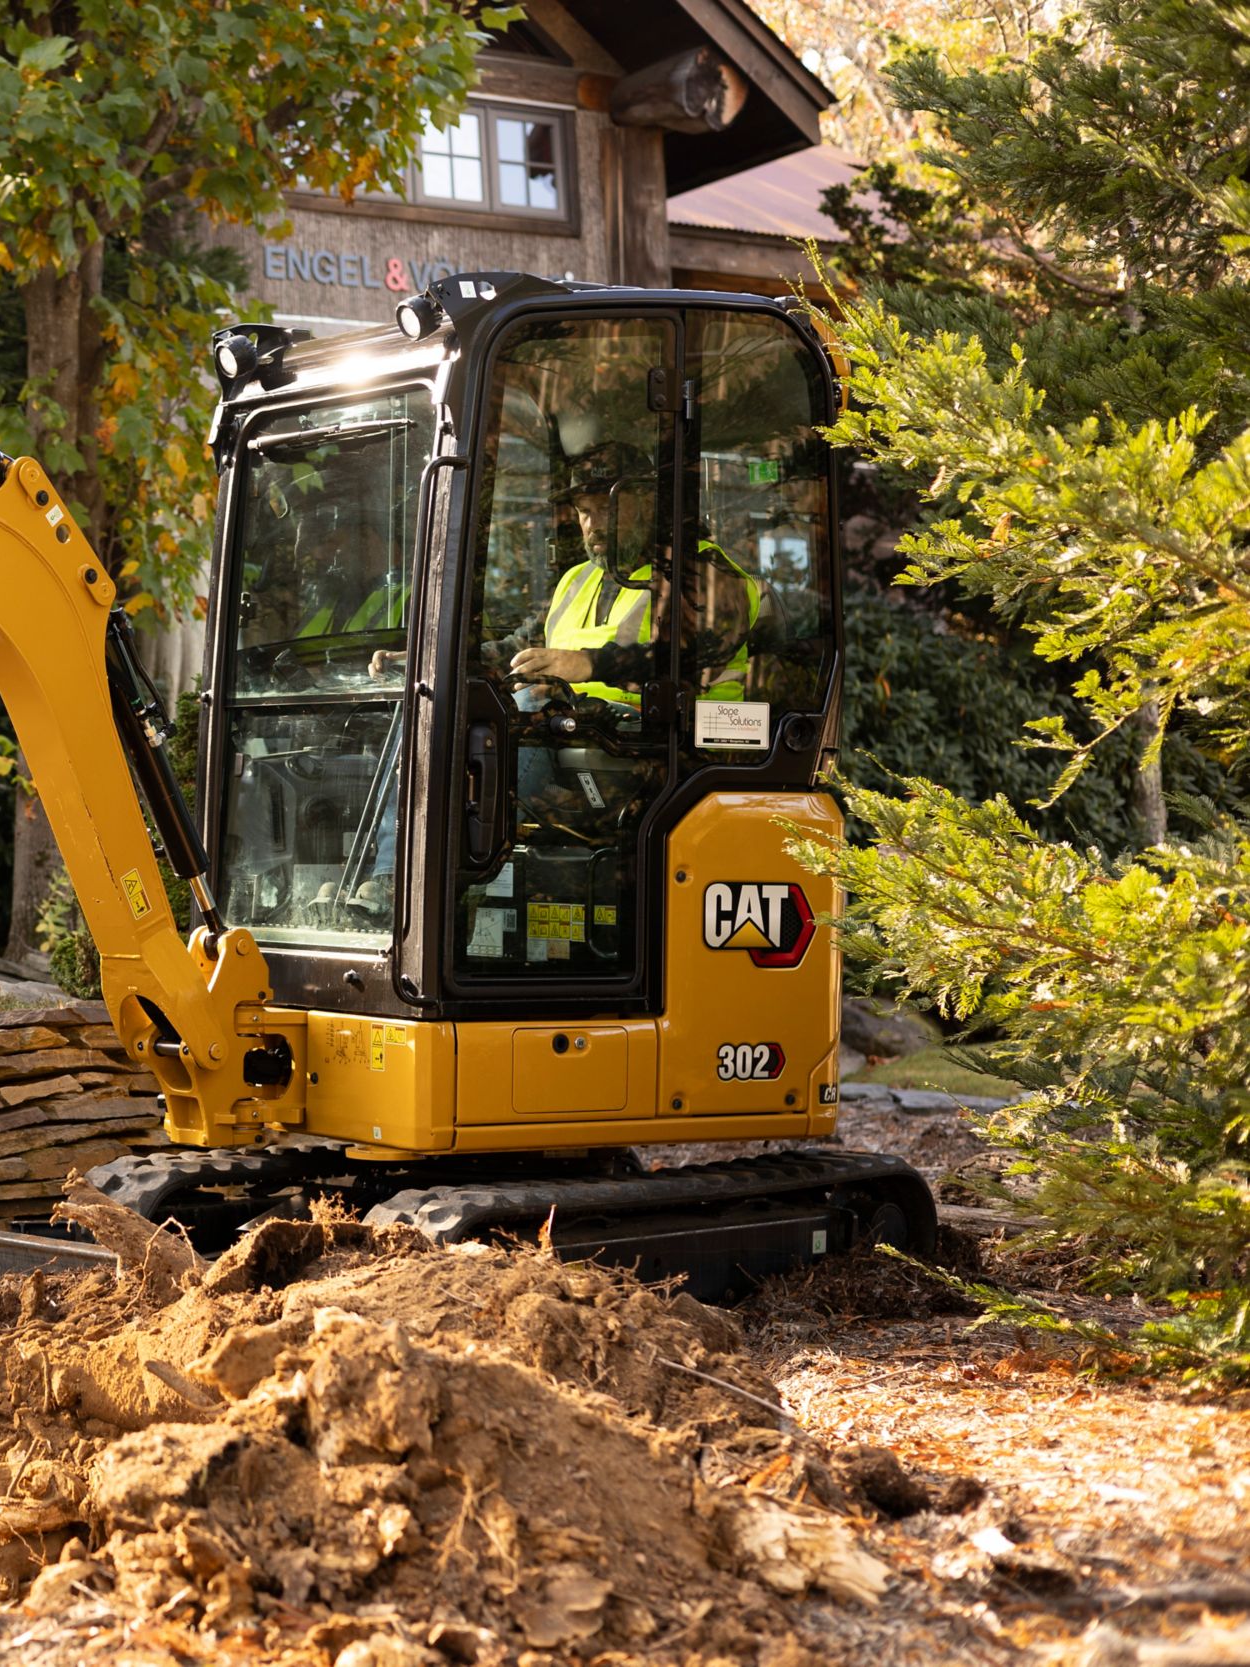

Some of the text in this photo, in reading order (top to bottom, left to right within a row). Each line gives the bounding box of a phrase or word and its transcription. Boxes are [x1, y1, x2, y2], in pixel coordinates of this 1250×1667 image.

[717, 704, 740, 717] Slope
[729, 716, 762, 727] Solutions
[704, 882, 789, 948] CAT
[718, 1044, 770, 1080] 302
